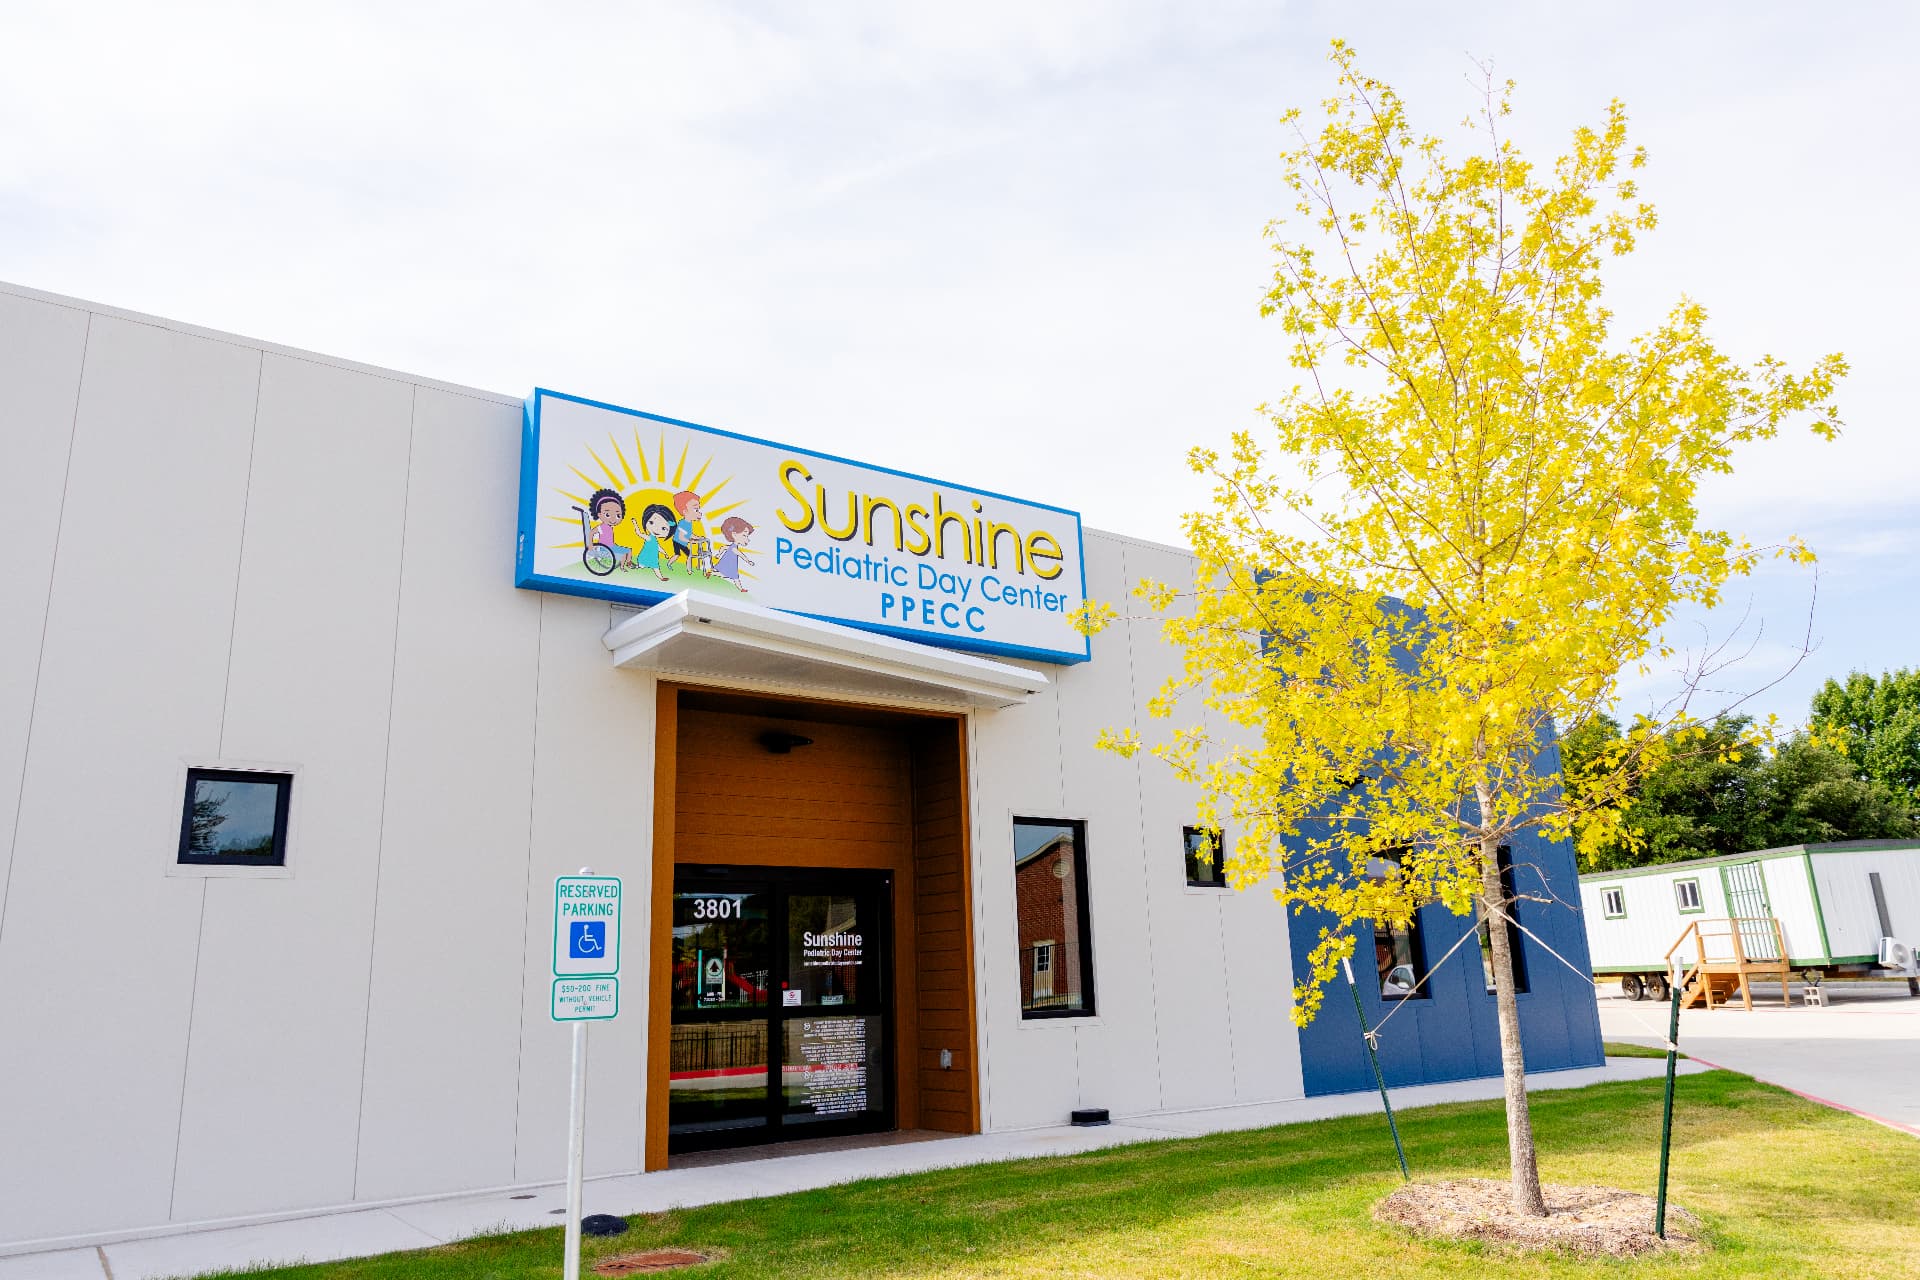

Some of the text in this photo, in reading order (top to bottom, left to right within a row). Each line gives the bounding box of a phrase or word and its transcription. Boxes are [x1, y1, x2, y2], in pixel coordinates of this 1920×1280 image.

[776, 460, 1064, 580] Sunshine
[776, 537, 1068, 613] Pediatric Day Center
[881, 592, 985, 632] PPECC
[560, 884, 618, 898] RESERVED
[563, 903, 614, 917] PARKING
[693, 898, 741, 919] 3801
[803, 931, 862, 947] Sunshine
[803, 948, 862, 958] Pediatric Day Center
[595, 983, 610, 992] FINE
[588, 994, 612, 1002] VEHICLE
[574, 1005, 596, 1013] PERMIT
